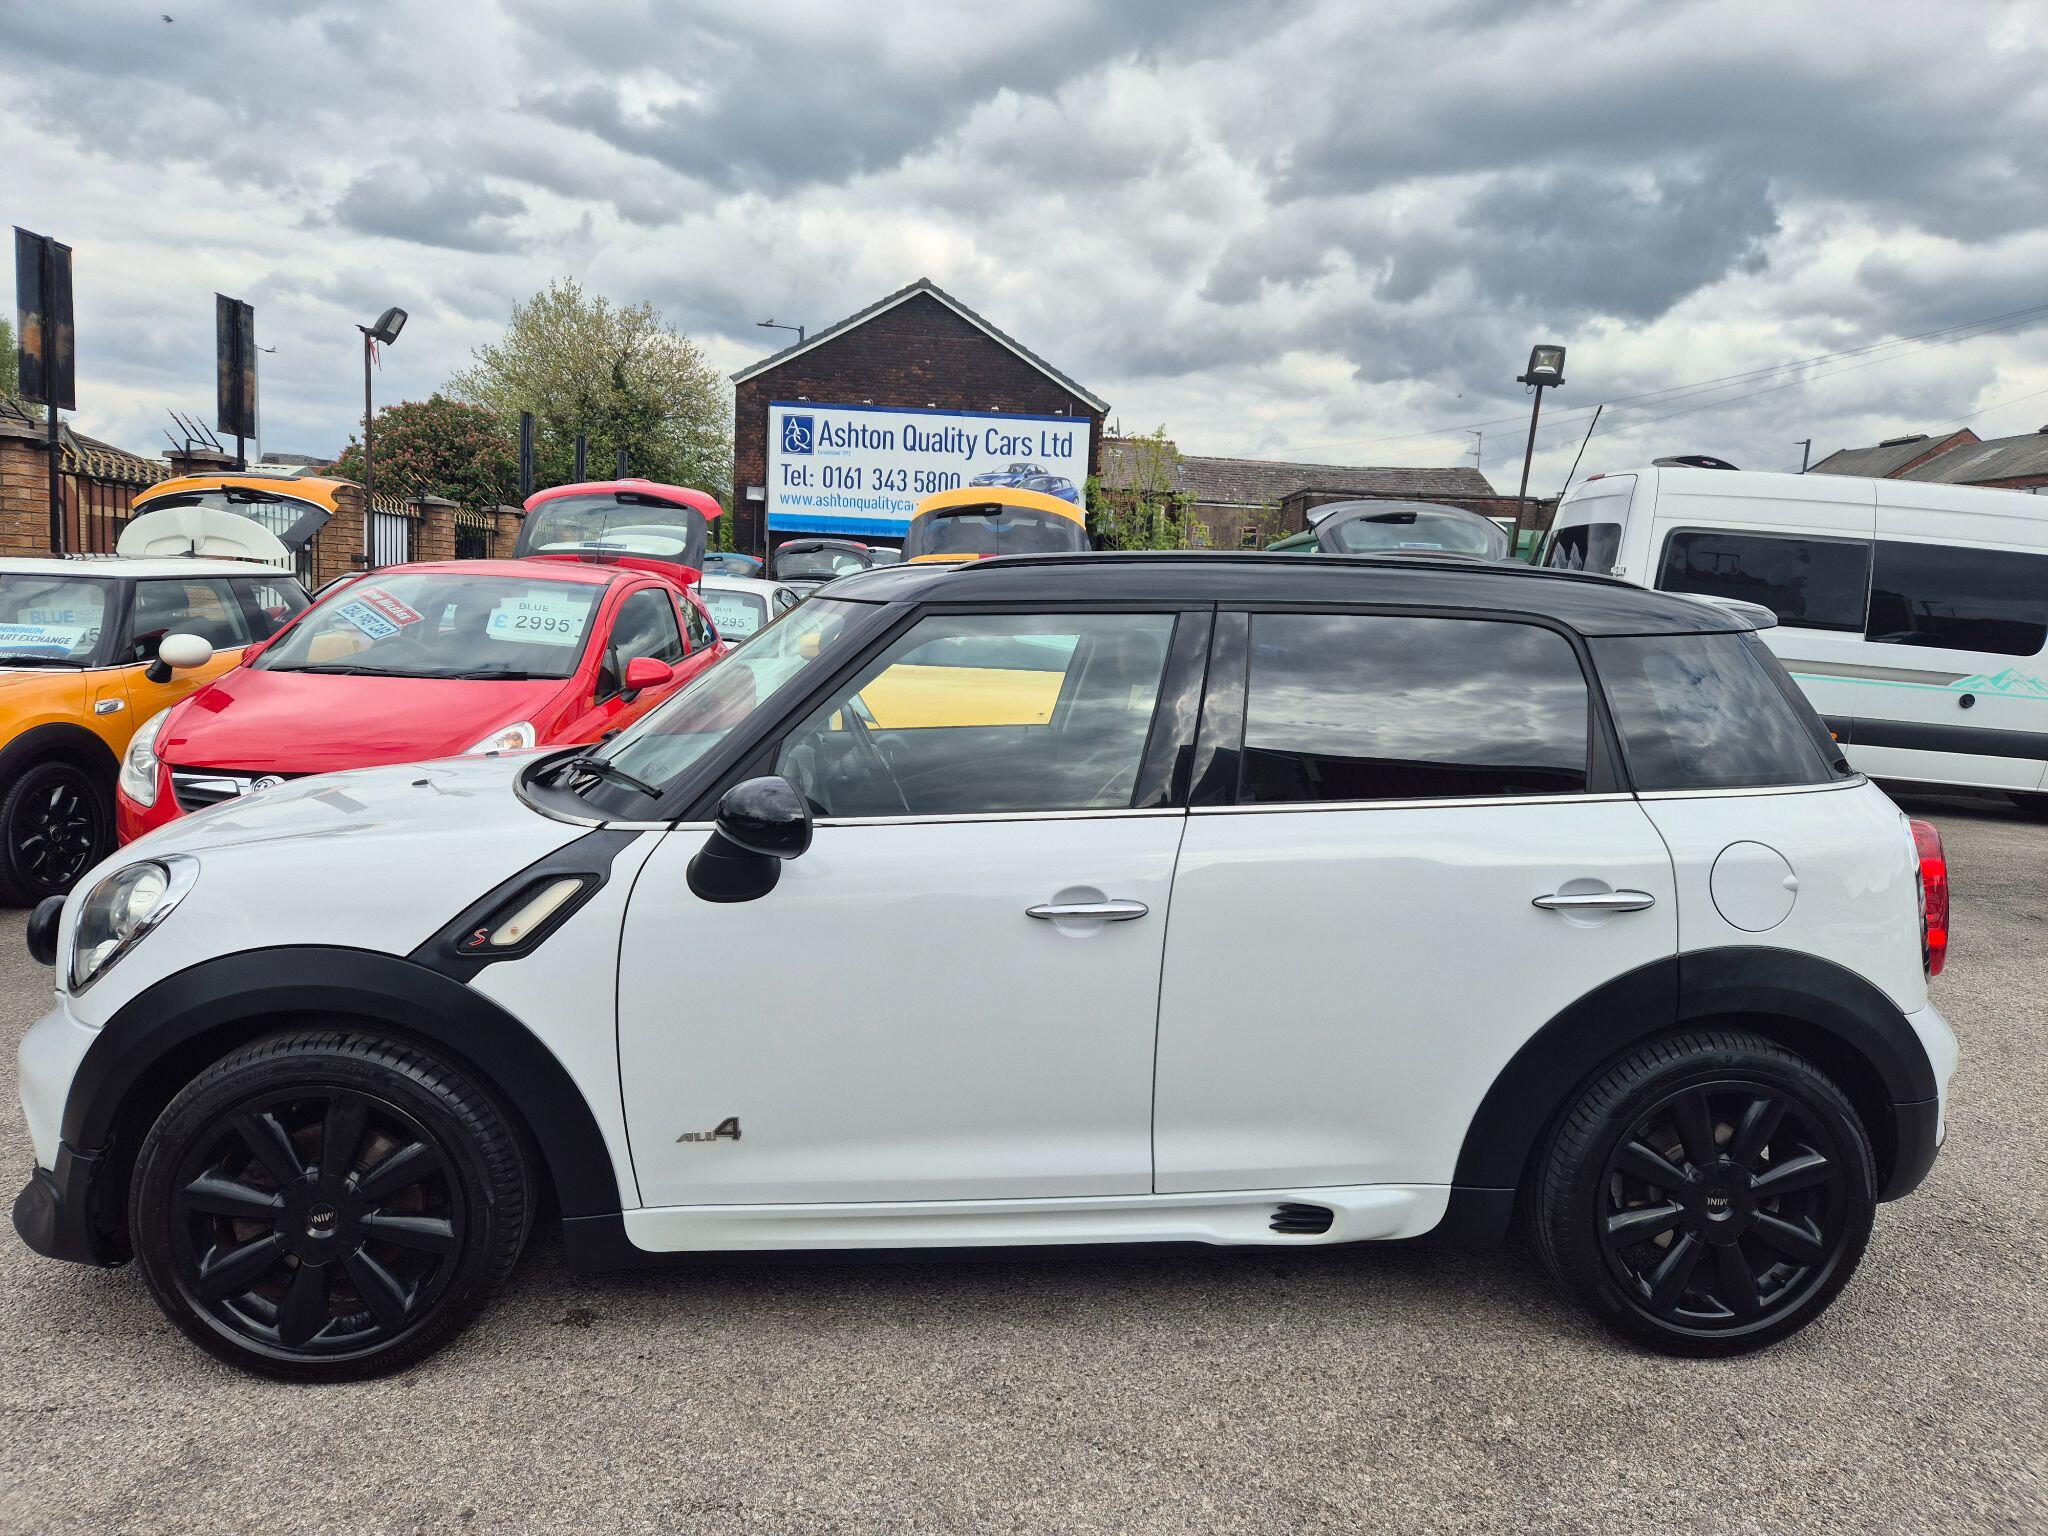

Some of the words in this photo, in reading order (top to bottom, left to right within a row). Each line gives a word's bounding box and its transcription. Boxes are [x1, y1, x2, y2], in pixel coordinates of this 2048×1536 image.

[818, 419, 894, 450] Ashton
[903, 424, 978, 460] Quality
[985, 427, 1033, 457] Cars
[1041, 430, 1073, 458] Ltd
[780, 463, 814, 487] Tel:
[822, 465, 862, 490] 0161
[872, 468, 908, 492] 343
[913, 470, 961, 493] 5800
[519, 602, 550, 612] BLUE
[31, 609, 75, 624] BLUE
[713, 616, 745, 628] 5295
[515, 615, 571, 633] 2995
[19, 634, 72, 645] EXCHANGE
[675, 1115, 742, 1143] ALL4
[1706, 1197, 1728, 1206] MINI
[310, 1211, 334, 1224] MINI
